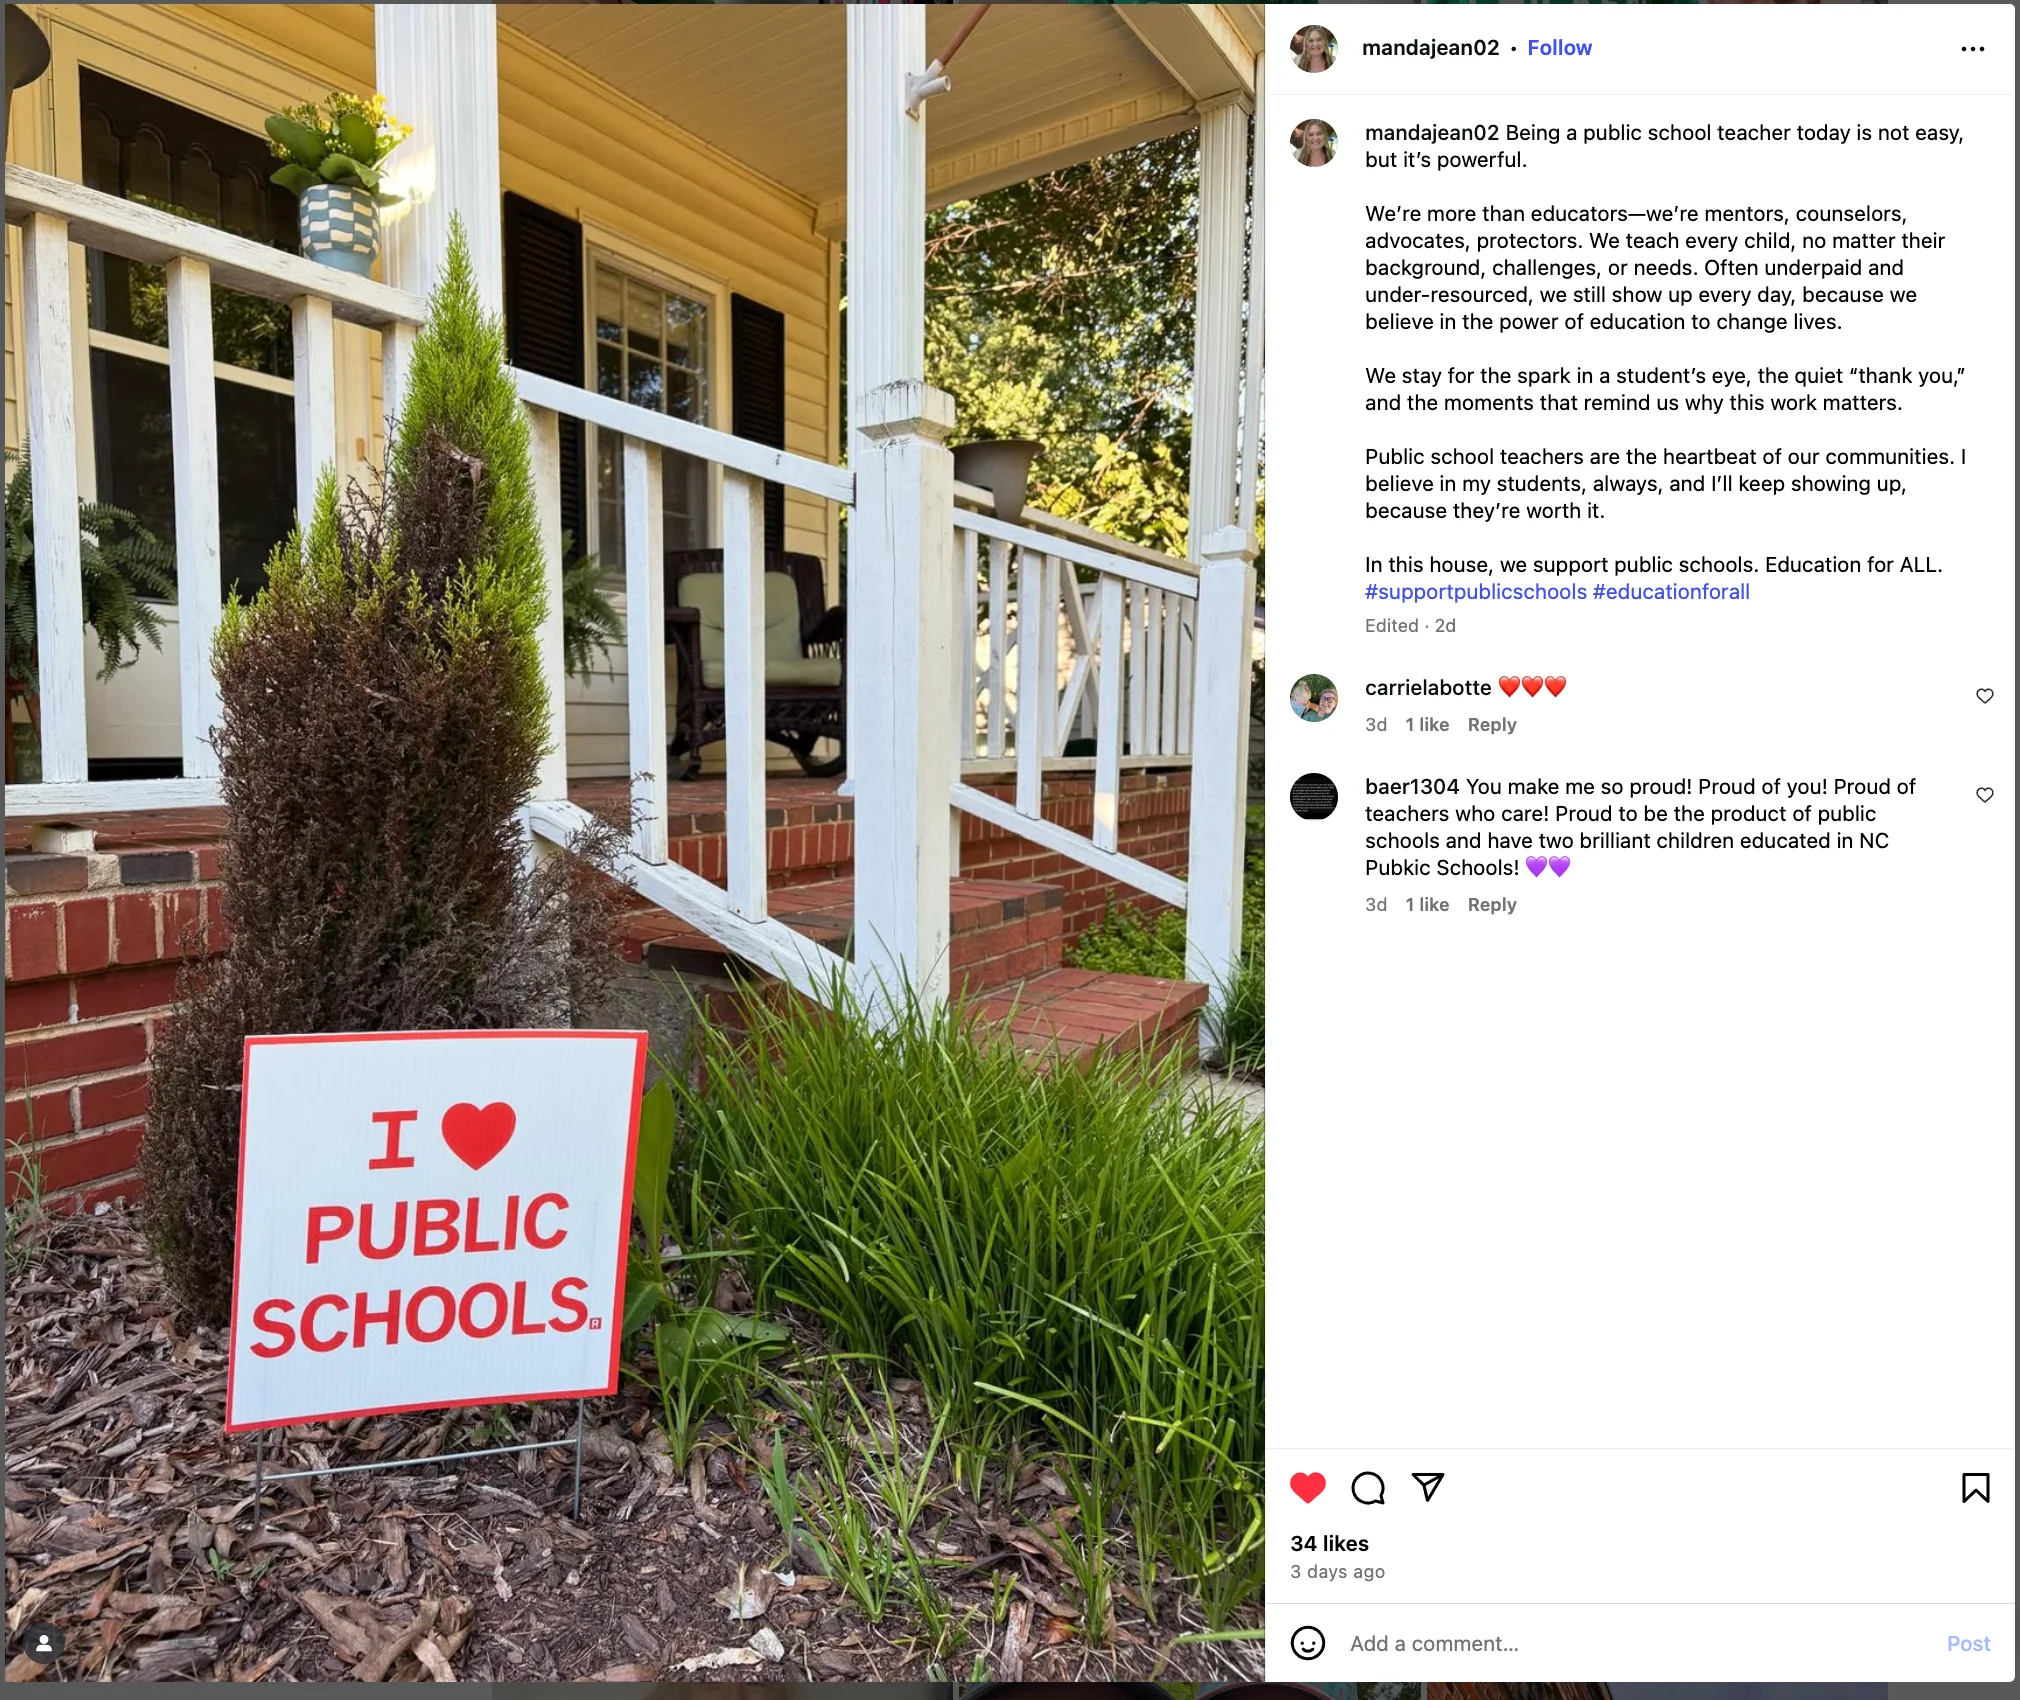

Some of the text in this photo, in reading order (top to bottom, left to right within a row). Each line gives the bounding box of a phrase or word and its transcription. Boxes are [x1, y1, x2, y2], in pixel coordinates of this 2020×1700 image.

[1363, 38, 1592, 59] mandajean02 Follow
[1366, 124, 1963, 144] mandajean02 Being a public school teacher today is not easy,
[1366, 151, 1397, 167] but
[1438, 151, 1526, 171] powerful.
[1428, 209, 1476, 221] more
[1482, 205, 1524, 221] than
[1706, 207, 1788, 225] mentors,
[1796, 205, 1906, 225] counselors,
[1366, 232, 1945, 252] advocates, protectors. We teach every child, no matter their
[1366, 259, 1903, 279] background, challenges, or needs. Often underpaid and
[1366, 286, 1916, 306] under-resourced, we still show up every day, because we
[1366, 313, 1841, 333] believe in the power of education to change lives.
[1366, 368, 1395, 383] We
[1402, 369, 1442, 387] stay
[1448, 367, 1474, 383] for
[1480, 367, 1511, 383] the
[1518, 367, 1571, 387] spark
[1578, 367, 1592, 383] in
[1600, 371, 1609, 383] a
[1712, 371, 1750, 387] eye,
[1758, 367, 1788, 383] the
[1795, 367, 1843, 387] quiet
[1366, 475, 1433, 491] believe
[1440, 475, 1455, 491] in
[1463, 479, 1491, 495] my
[1497, 475, 1585, 495] students,
[1593, 475, 1662, 495] always,
[1670, 475, 1704, 491] and
[1740, 475, 1785, 495] keep
[1792, 475, 1870, 495] showing
[1878, 479, 1905, 495] up,
[1366, 502, 1446, 518] because
[1527, 502, 1580, 518] worth
[1588, 502, 1604, 518] it.
[1367, 556, 1942, 576] In this house, we support public schools. Education for ALL.
[1365, 583, 1749, 603] #supportpublicschools #educationforall
[1366, 618, 1455, 632] Edited 2d
[1366, 679, 1491, 695] carrielabotte
[1366, 717, 1517, 734] 3d 1 like Reply
[1366, 778, 1916, 798] baer1304 You make me so proud! Proud of you! Proud of
[1365, 805, 1876, 825] teachers who care! Proud to be the product of public
[1366, 832, 1888, 849] schools and have two brilliant children educated in NC
[1367, 859, 1518, 876] Pubkic Schools!
[1366, 897, 1517, 914] 3d 1 like Reply
[369, 1111, 417, 1169] I
[306, 1193, 569, 1264] PUBLIC
[1291, 1534, 1369, 1551] 34 likes
[1291, 1564, 1385, 1581] 3 days ago
[1351, 1635, 1387, 1651] Add
[1395, 1639, 1405, 1651] a
[1949, 1636, 1990, 1651] Post
